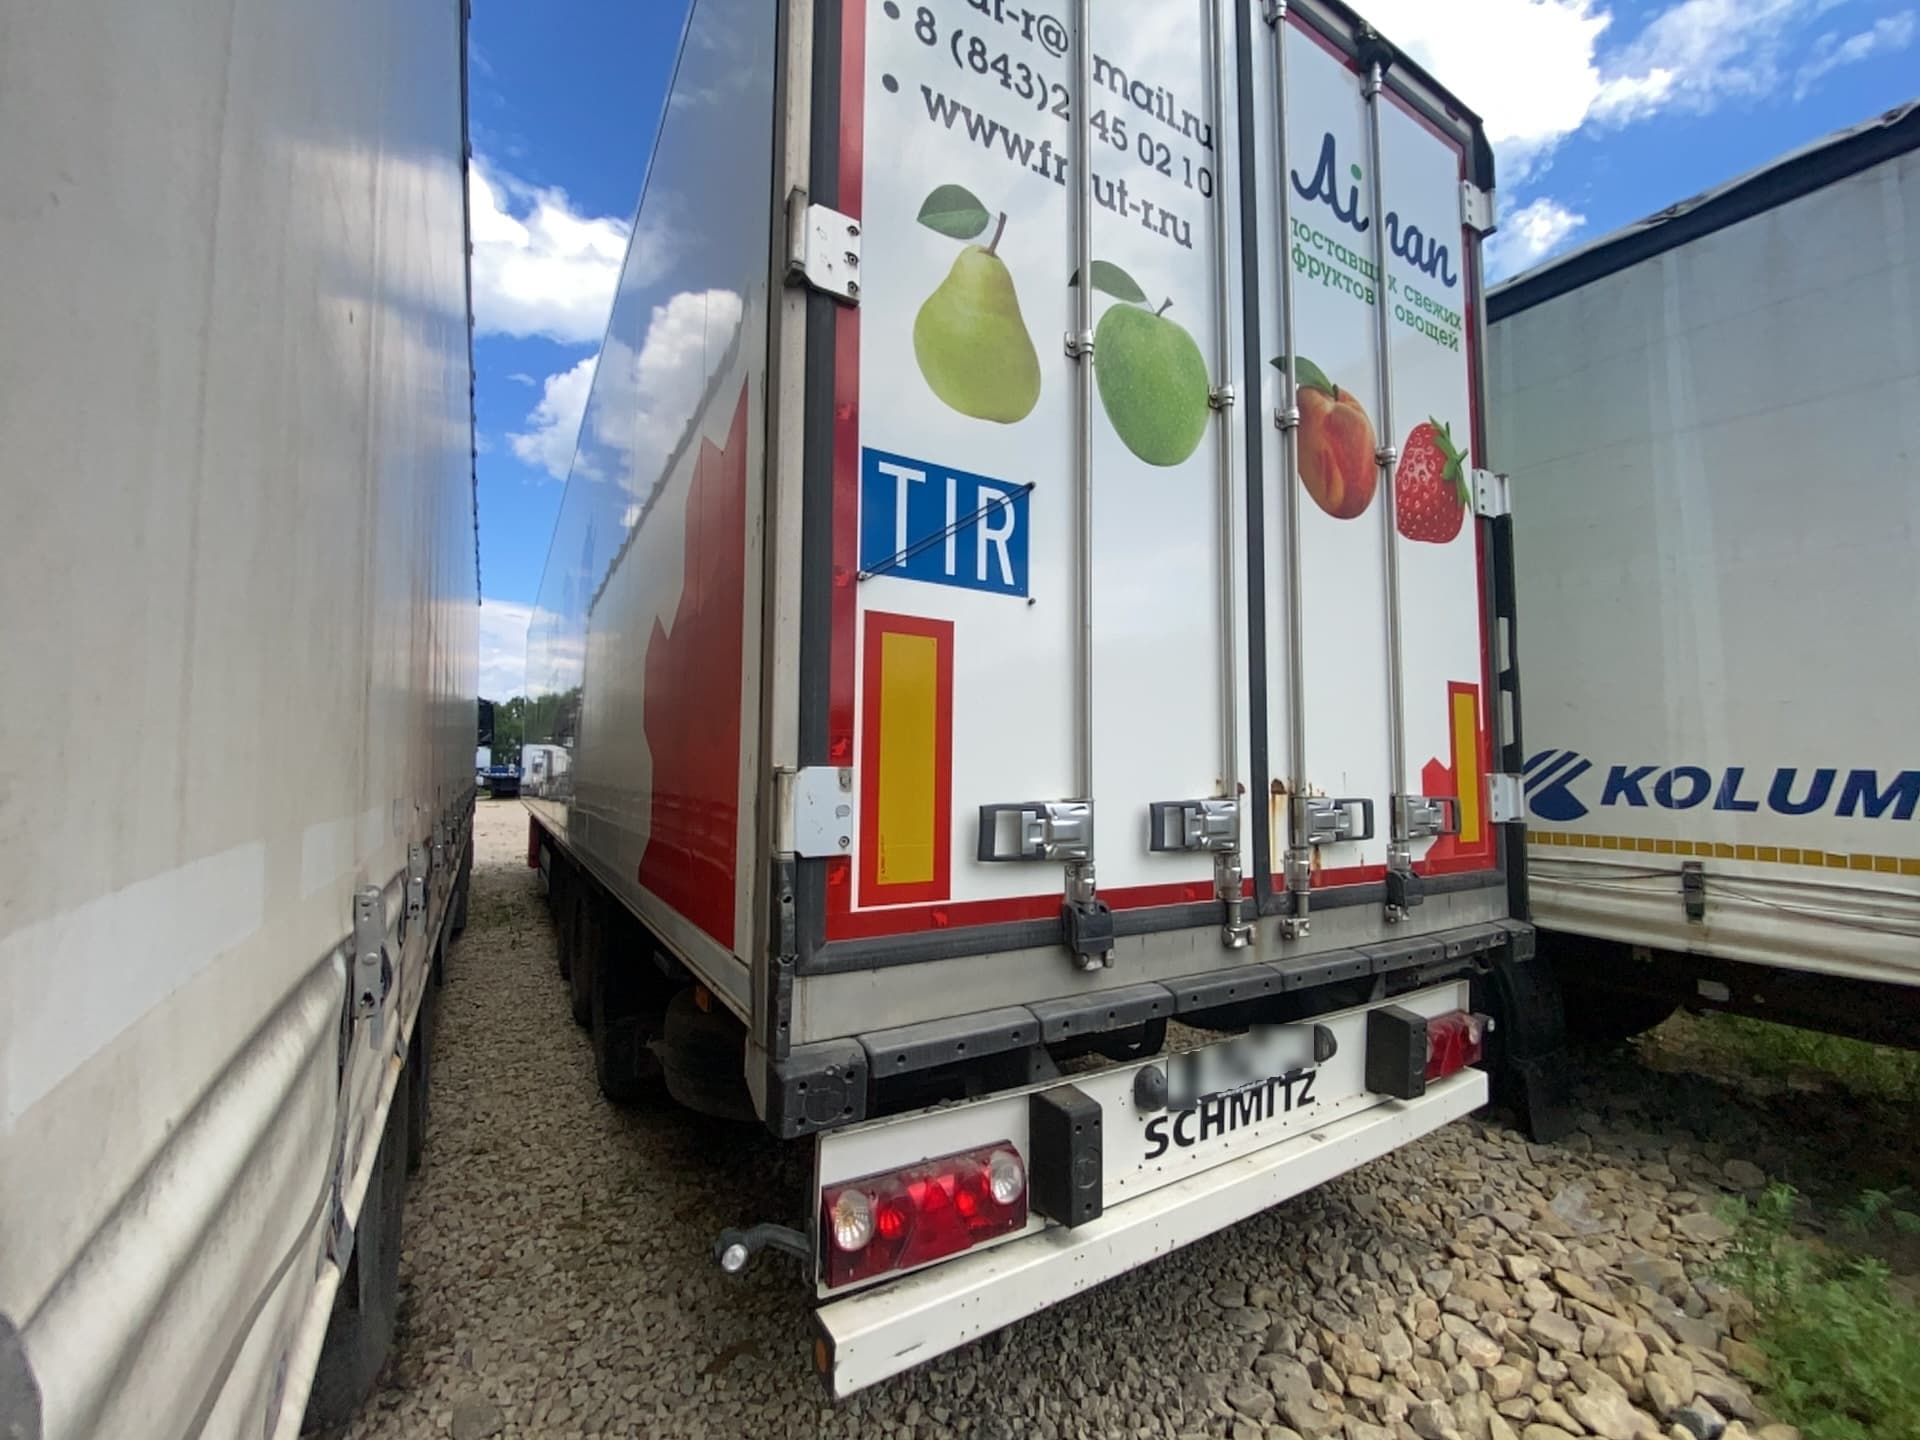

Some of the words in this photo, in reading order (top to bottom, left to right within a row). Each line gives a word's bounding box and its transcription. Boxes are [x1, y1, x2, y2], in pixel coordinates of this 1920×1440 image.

[914, 6, 938, 46] 8
[1137, 133, 1172, 178] 02
[1182, 156, 1213, 199] 10
[1291, 242, 1375, 306] фруктов
[1394, 303, 1459, 353] овощей
[1403, 284, 1462, 331] свежих
[878, 461, 1016, 586] TIR
[1600, 765, 1920, 820] KOLUM
[1145, 1071, 1316, 1160] SCHMITZ
